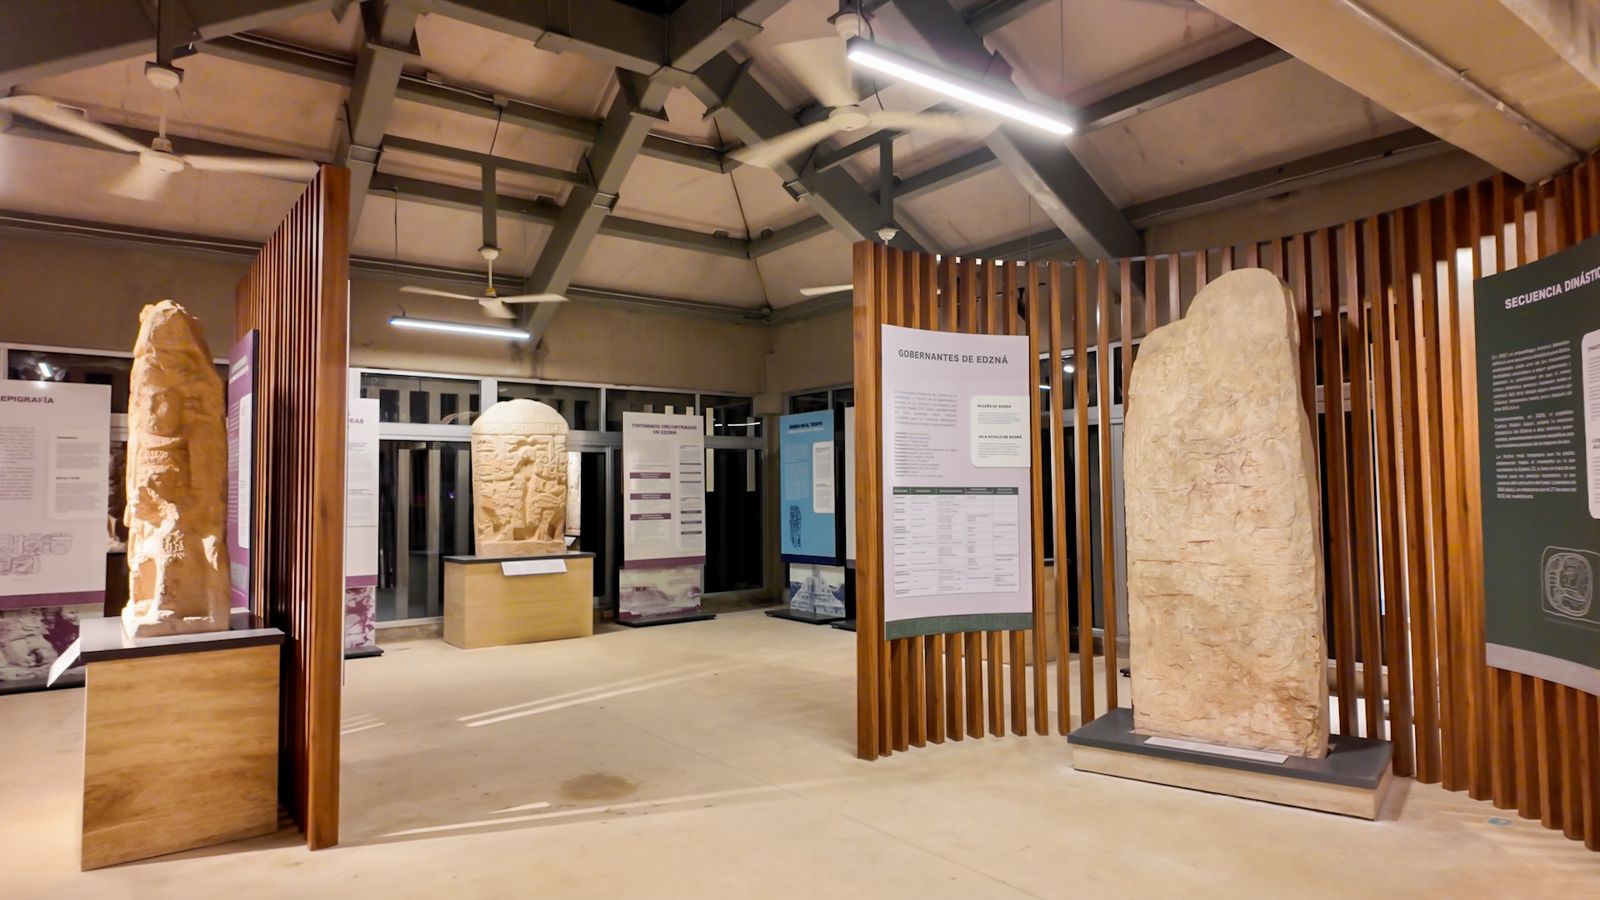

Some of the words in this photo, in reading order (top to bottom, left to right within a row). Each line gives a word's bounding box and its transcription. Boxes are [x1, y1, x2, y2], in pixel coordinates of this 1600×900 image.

[1504, 283, 1562, 309] SECUENCIA
[898, 349, 959, 362] GOBERNANTES
[961, 354, 974, 363] DE
[976, 354, 1009, 364] EDZNÁ
[0, 395, 54, 404] EPIGRAFÍA
